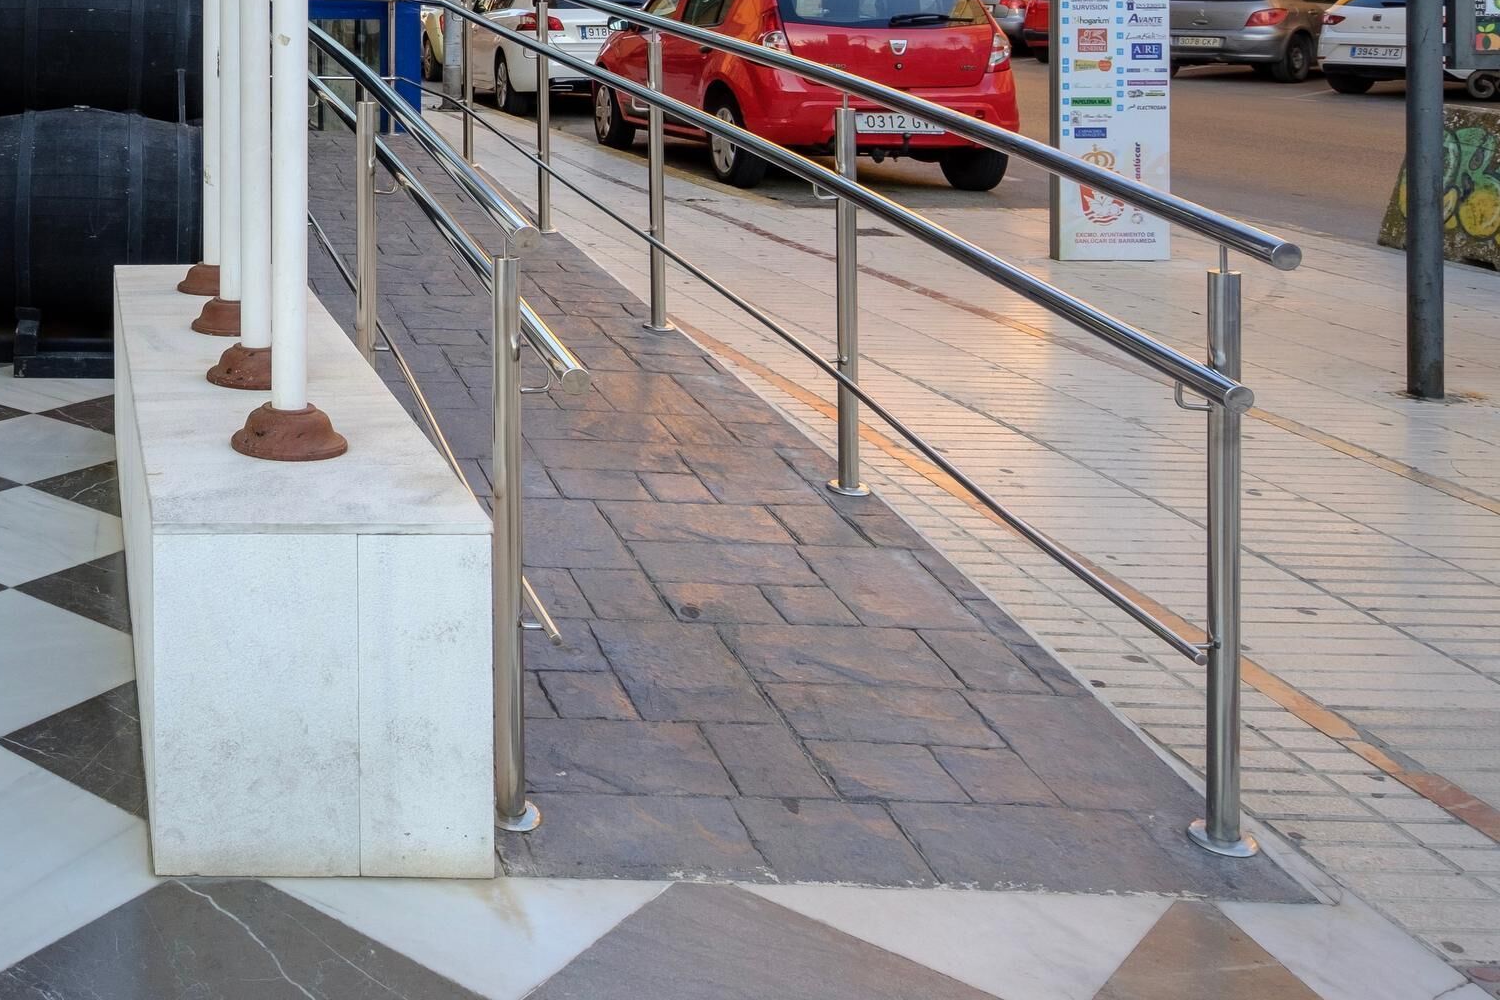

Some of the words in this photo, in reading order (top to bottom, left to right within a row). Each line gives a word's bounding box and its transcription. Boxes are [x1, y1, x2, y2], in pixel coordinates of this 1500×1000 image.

[1128, 13, 1163, 24] AVANTE
[1357, 47, 1379, 56] 3945
[1381, 49, 1400, 57] JYZ
[866, 114, 906, 129] 0312
[1133, 142, 1141, 182] anlúcar
